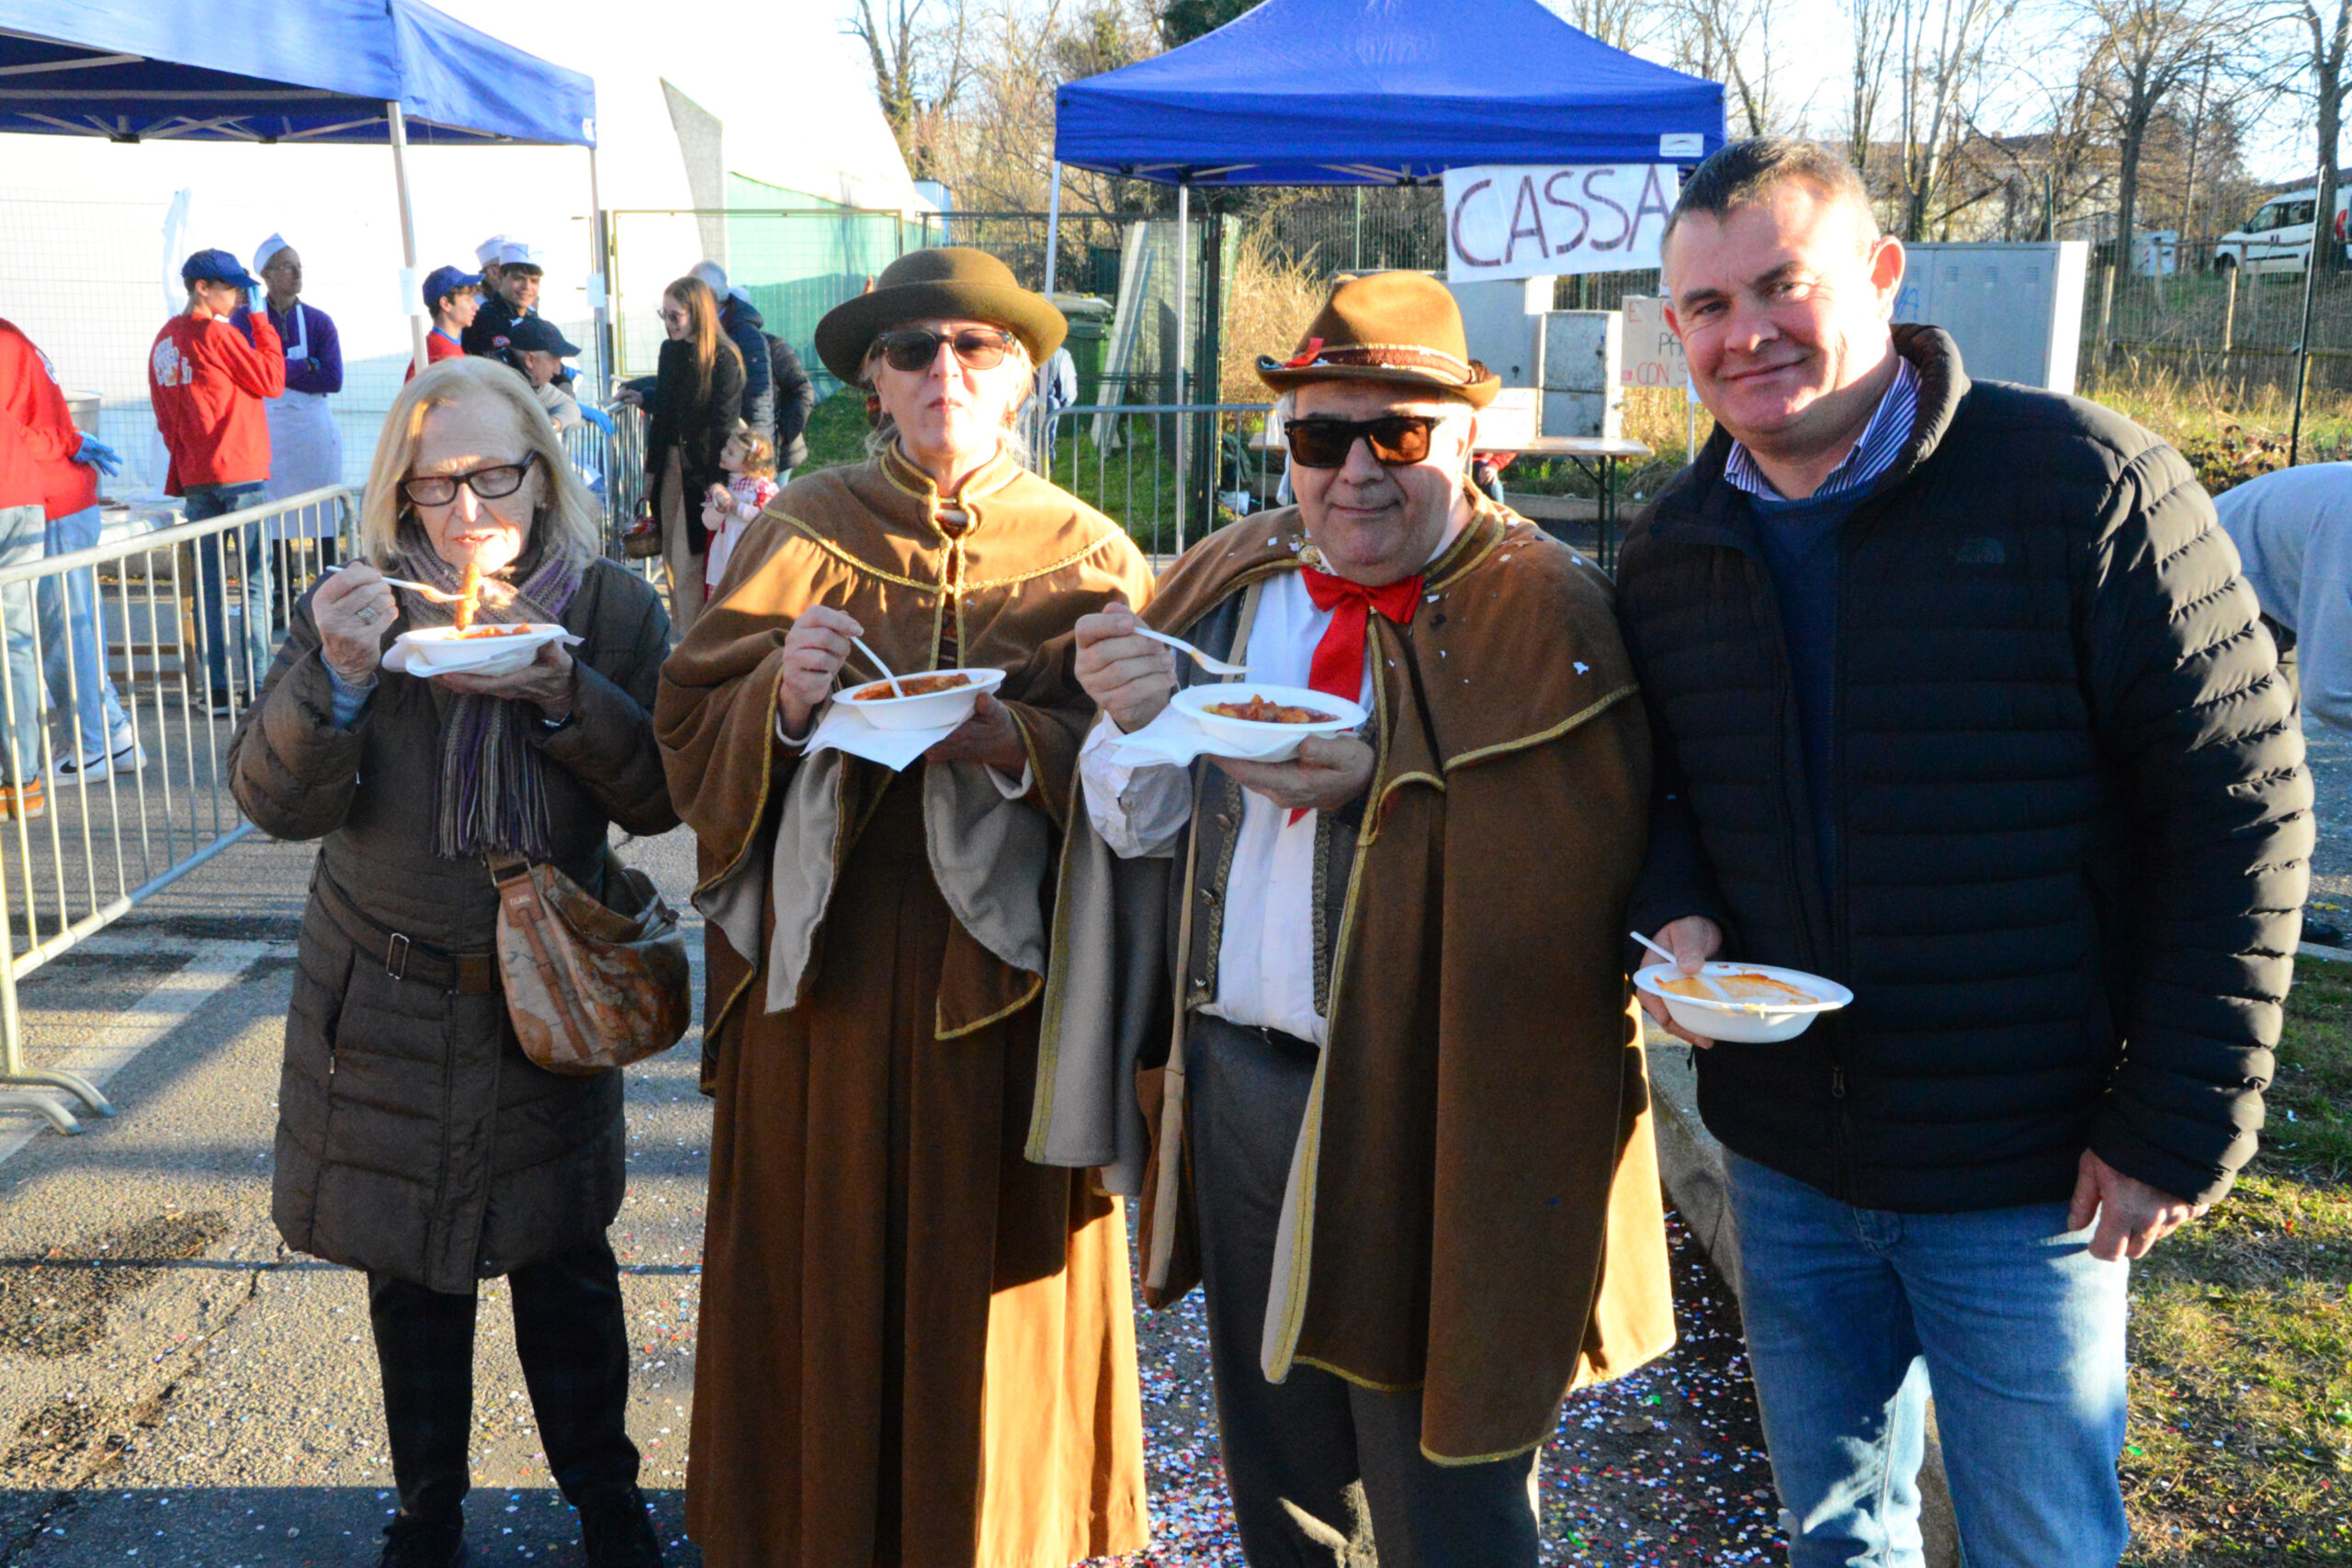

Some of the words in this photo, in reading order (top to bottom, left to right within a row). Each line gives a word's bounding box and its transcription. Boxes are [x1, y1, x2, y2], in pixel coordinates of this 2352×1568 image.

[1452, 164, 1670, 267] CASSA
[1627, 300, 1643, 322] E
[1636, 361, 1669, 385] CON
